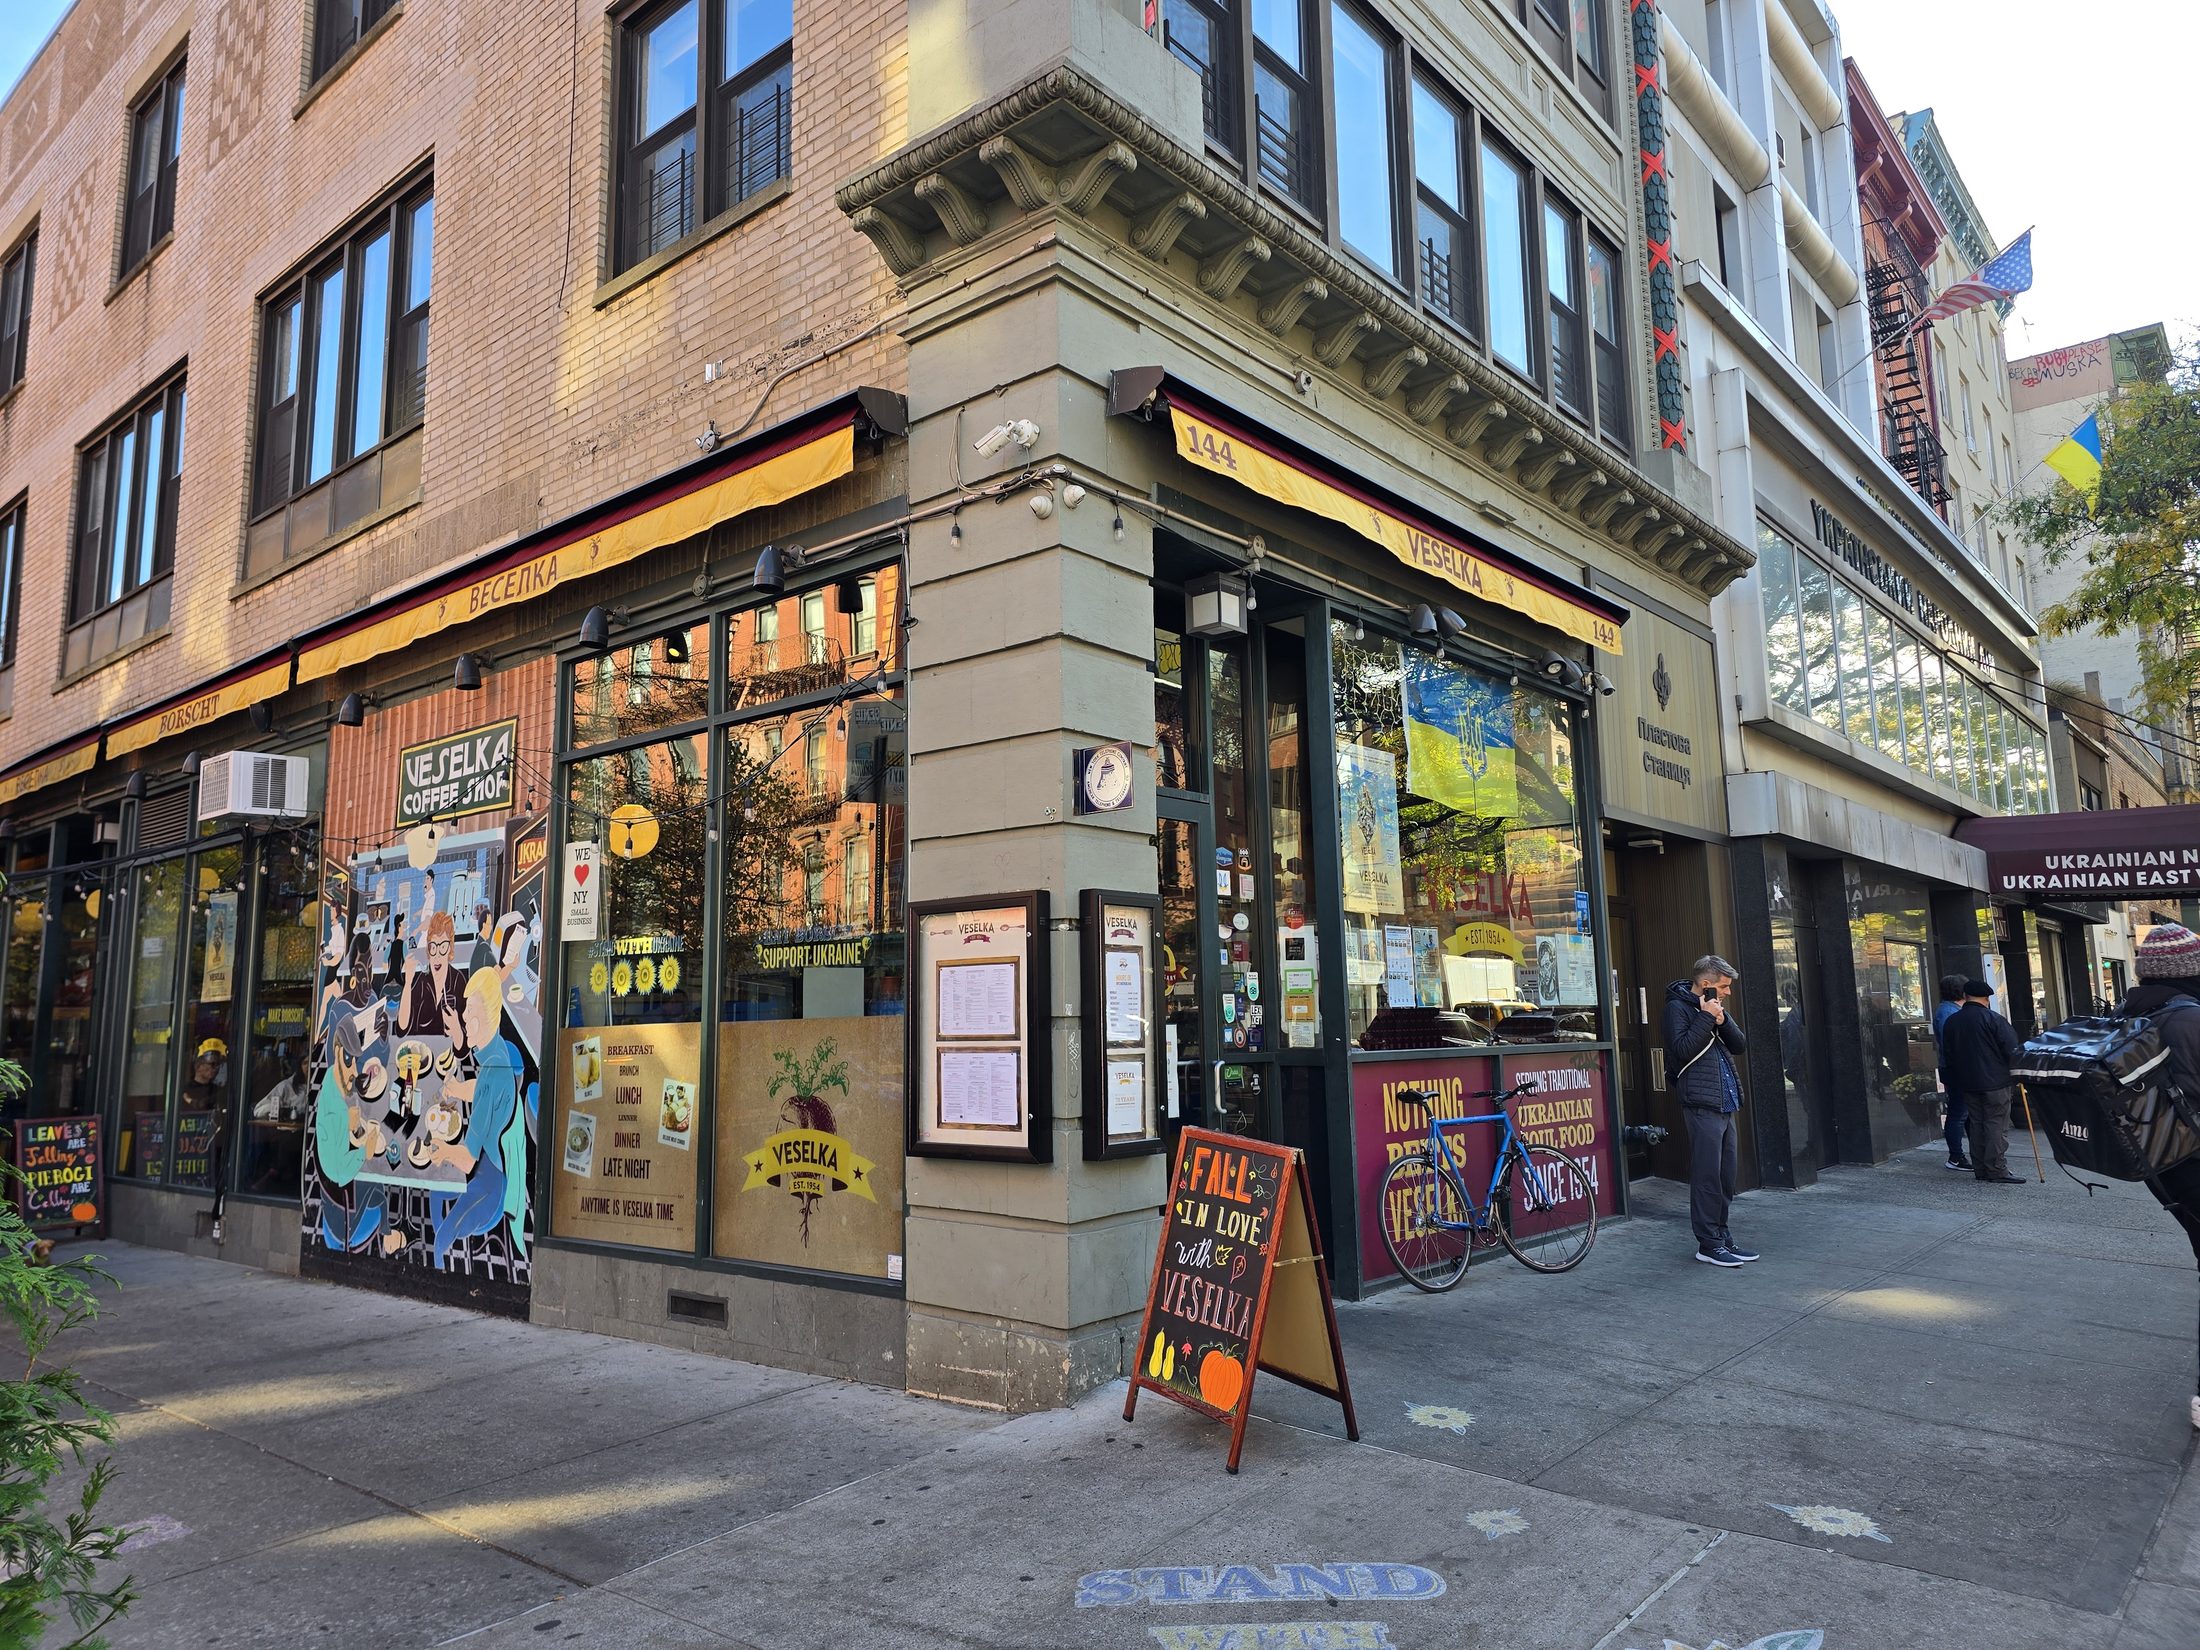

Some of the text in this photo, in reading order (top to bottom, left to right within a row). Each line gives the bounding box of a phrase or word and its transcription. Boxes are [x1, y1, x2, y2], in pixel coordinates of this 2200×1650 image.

[2040, 355, 2102, 383] MUSKA
[1186, 425, 1237, 470] 144
[1405, 528, 1483, 595] VESELKA
[1592, 620, 1615, 645] 144
[159, 694, 220, 734] BORSCHT
[1637, 716, 1692, 756] Пластова
[405, 730, 509, 788] VESELKA
[1643, 751, 1691, 789] Станиця
[403, 770, 505, 815] COFFEE SHOP
[575, 847, 591, 861] WE
[2045, 851, 2176, 870] UKRAINIAN
[2003, 869, 2191, 889] UKRAINIAN EAST
[572, 890, 589, 905] NY
[567, 917, 592, 926] BUSINESS
[570, 908, 590, 916] SMALL
[1106, 917, 1138, 930] VESELKA
[958, 922, 995, 935] VESELKA
[1485, 929, 1501, 945] 1954
[762, 942, 862, 969] SUPPORT UKRAINE
[607, 1044, 654, 1056] BREAKFAST
[619, 1065, 639, 1077] BRUNCH
[1548, 1068, 1591, 1091] TRADITIONAL
[615, 1087, 642, 1105] LUNCH
[1383, 1076, 1464, 1134] NOTHING
[1517, 1098, 1593, 1128] UKRAINIAN
[28, 1123, 82, 1142] LEAVES
[67, 1138, 87, 1150] ARE
[614, 1132, 640, 1149] DINNER
[1559, 1123, 1595, 1149] FOOD
[25, 1146, 77, 1168] Falling
[603, 1157, 622, 1177] LATE
[624, 1159, 651, 1179] NIGHT
[772, 1139, 838, 1172] VESELKA
[28, 1166, 93, 1187] PIEROGI
[792, 1180, 820, 1192] EST. 1954
[1189, 1146, 1252, 1204] FALL
[1523, 1155, 1599, 1212] SINCE 1954
[70, 1182, 91, 1195] ARE
[580, 1196, 674, 1221] ANYTIME IS VESELKA TIME
[1389, 1180, 1465, 1243] VESELK
[1180, 1199, 1263, 1247] IN LOVE
[1174, 1238, 1214, 1269] with
[1160, 1268, 1254, 1341] VESELKA
[1075, 1562, 1448, 1609] STAND
